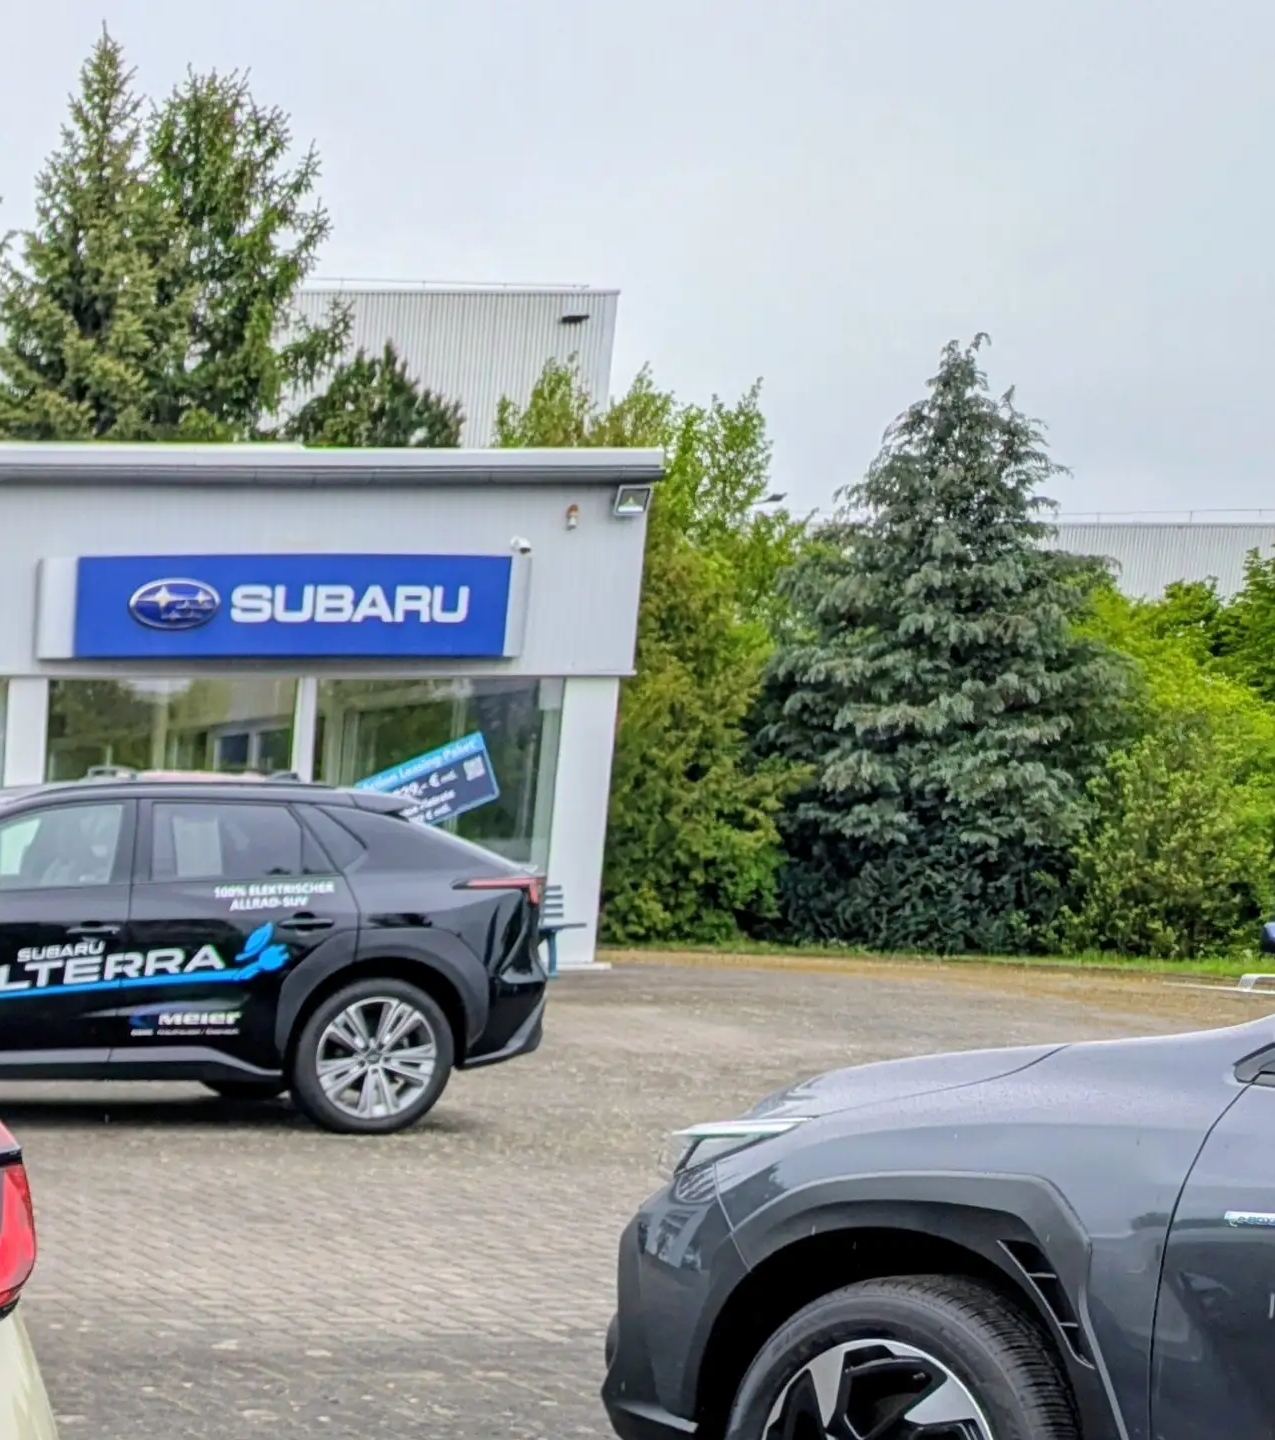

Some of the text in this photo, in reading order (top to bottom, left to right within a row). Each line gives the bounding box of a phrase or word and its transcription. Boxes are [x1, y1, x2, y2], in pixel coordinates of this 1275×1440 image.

[230, 584, 471, 624] SUBARU
[213, 881, 335, 898] 100% ELEKTRISCHER
[229, 896, 309, 911] ALLRAD-SUV
[16, 940, 107, 963] SUBARU
